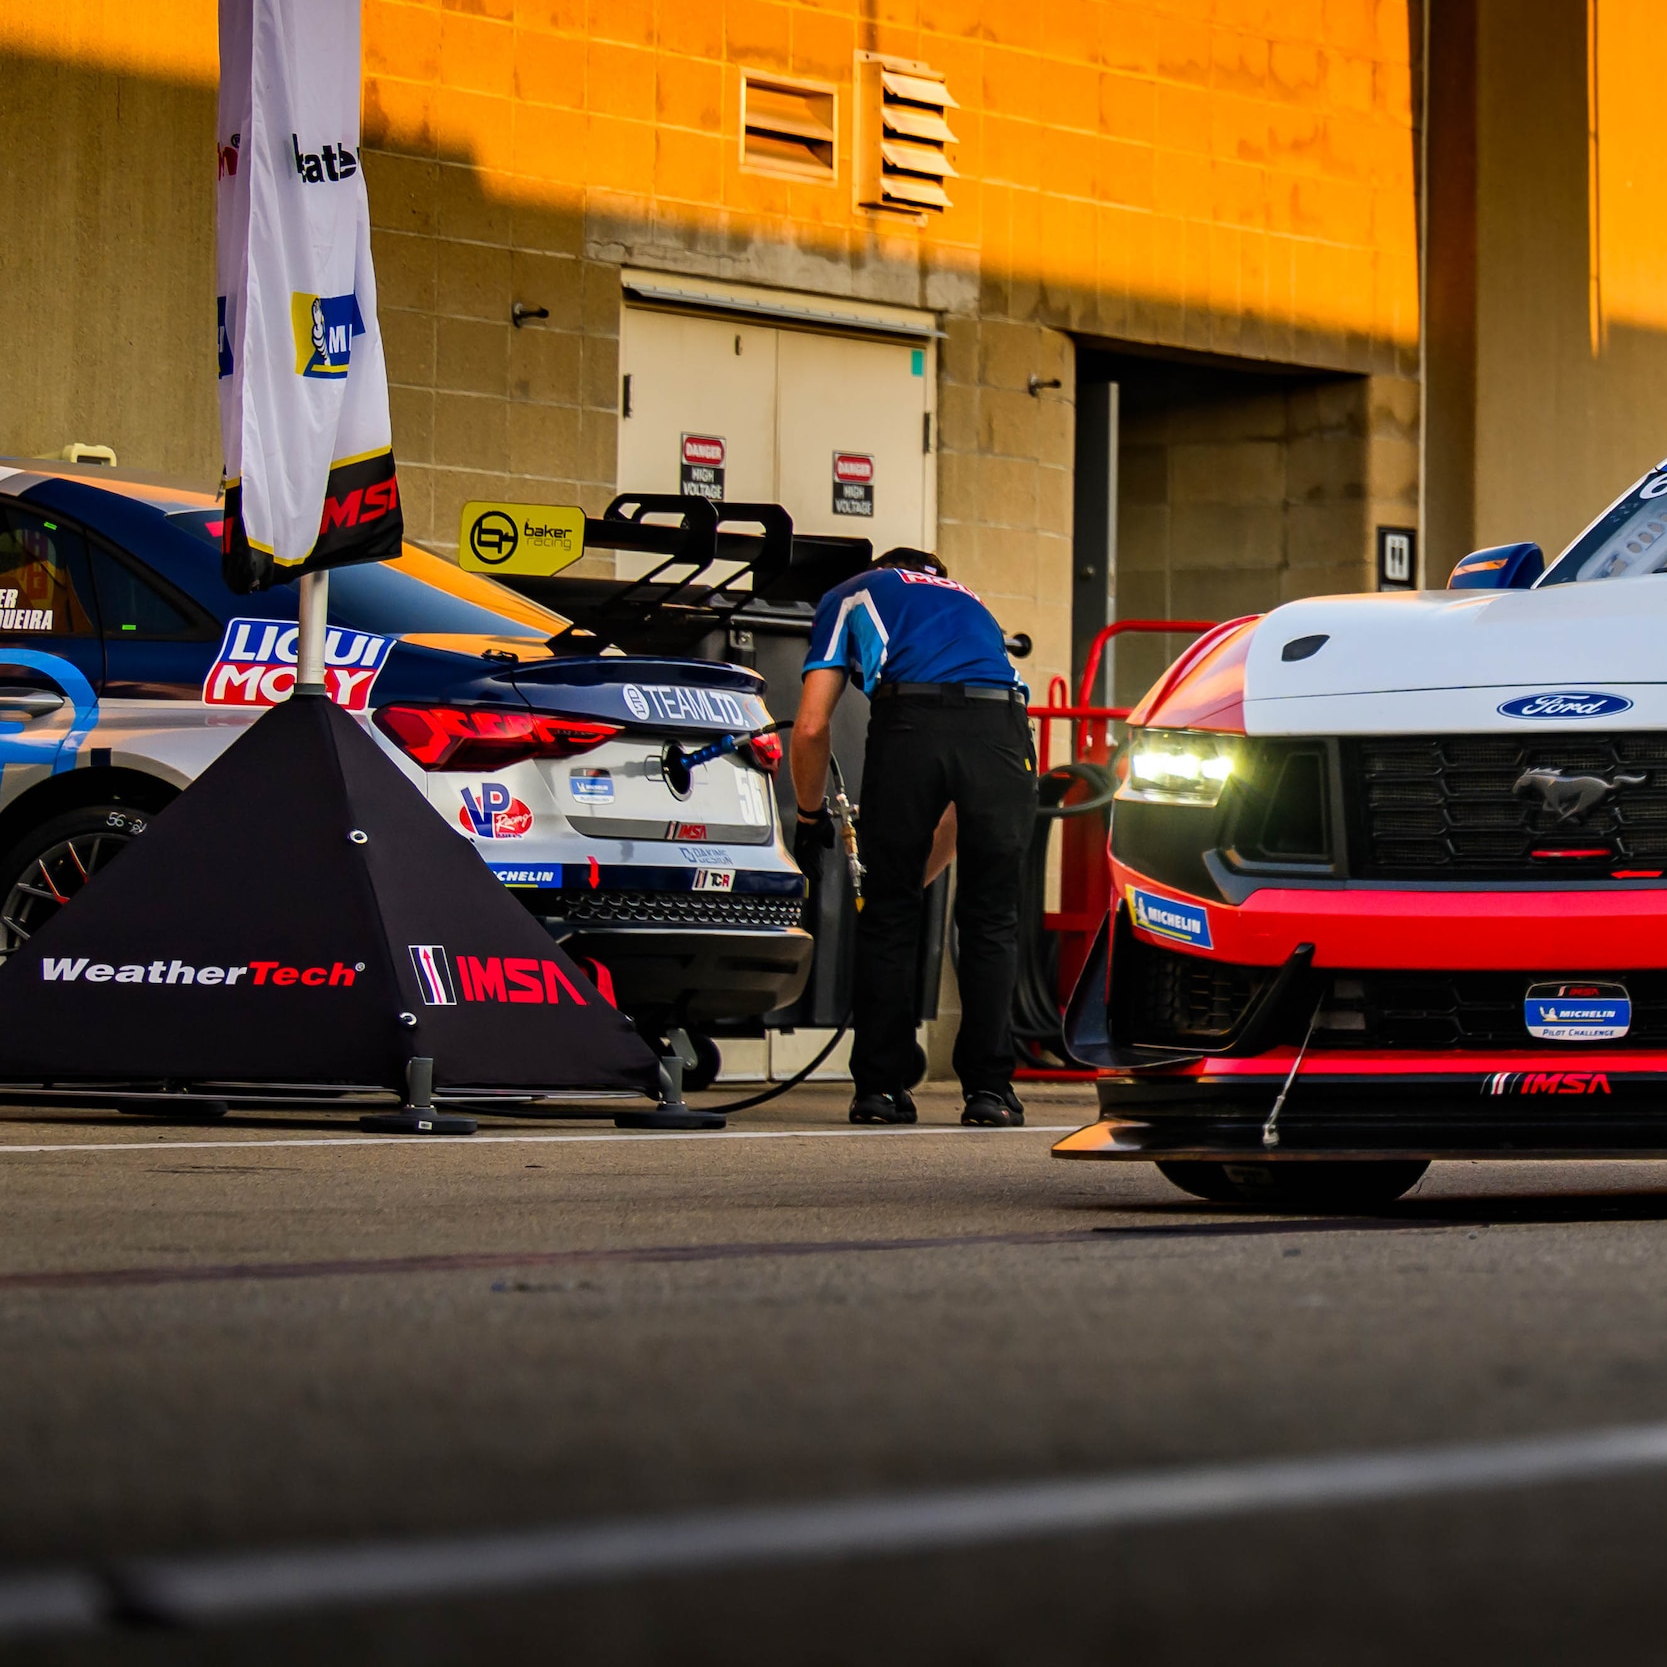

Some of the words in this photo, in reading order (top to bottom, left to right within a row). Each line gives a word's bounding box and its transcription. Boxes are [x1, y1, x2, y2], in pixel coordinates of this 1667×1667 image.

[685, 441, 722, 460] DANGER
[691, 468, 715, 483] HIGH
[836, 461, 872, 478] DANGER
[683, 481, 722, 500] VOLTAGE
[843, 485, 864, 499] HIGH
[835, 500, 872, 516] VOLTAGE
[524, 520, 573, 538] baker
[526, 537, 572, 551] racing
[203, 664, 374, 705] MOY
[1522, 695, 1608, 715] Ford
[735, 766, 768, 827] 56
[460, 782, 511, 839] VP
[495, 813, 532, 831] Racing
[677, 824, 708, 840] IMSA
[496, 870, 554, 882] CHELIN
[710, 872, 730, 887] TCR
[1147, 906, 1201, 935] MICHELIN
[42, 957, 357, 987] WeatherTech
[456, 955, 588, 1006] IMSA
[1569, 987, 1600, 996] IMSA
[1559, 1010, 1616, 1019] MICHELIN
[1542, 1028, 1566, 1036] PILOT
[1568, 1028, 1614, 1037] CHALLENGE
[1520, 1073, 1612, 1095] IMSA
